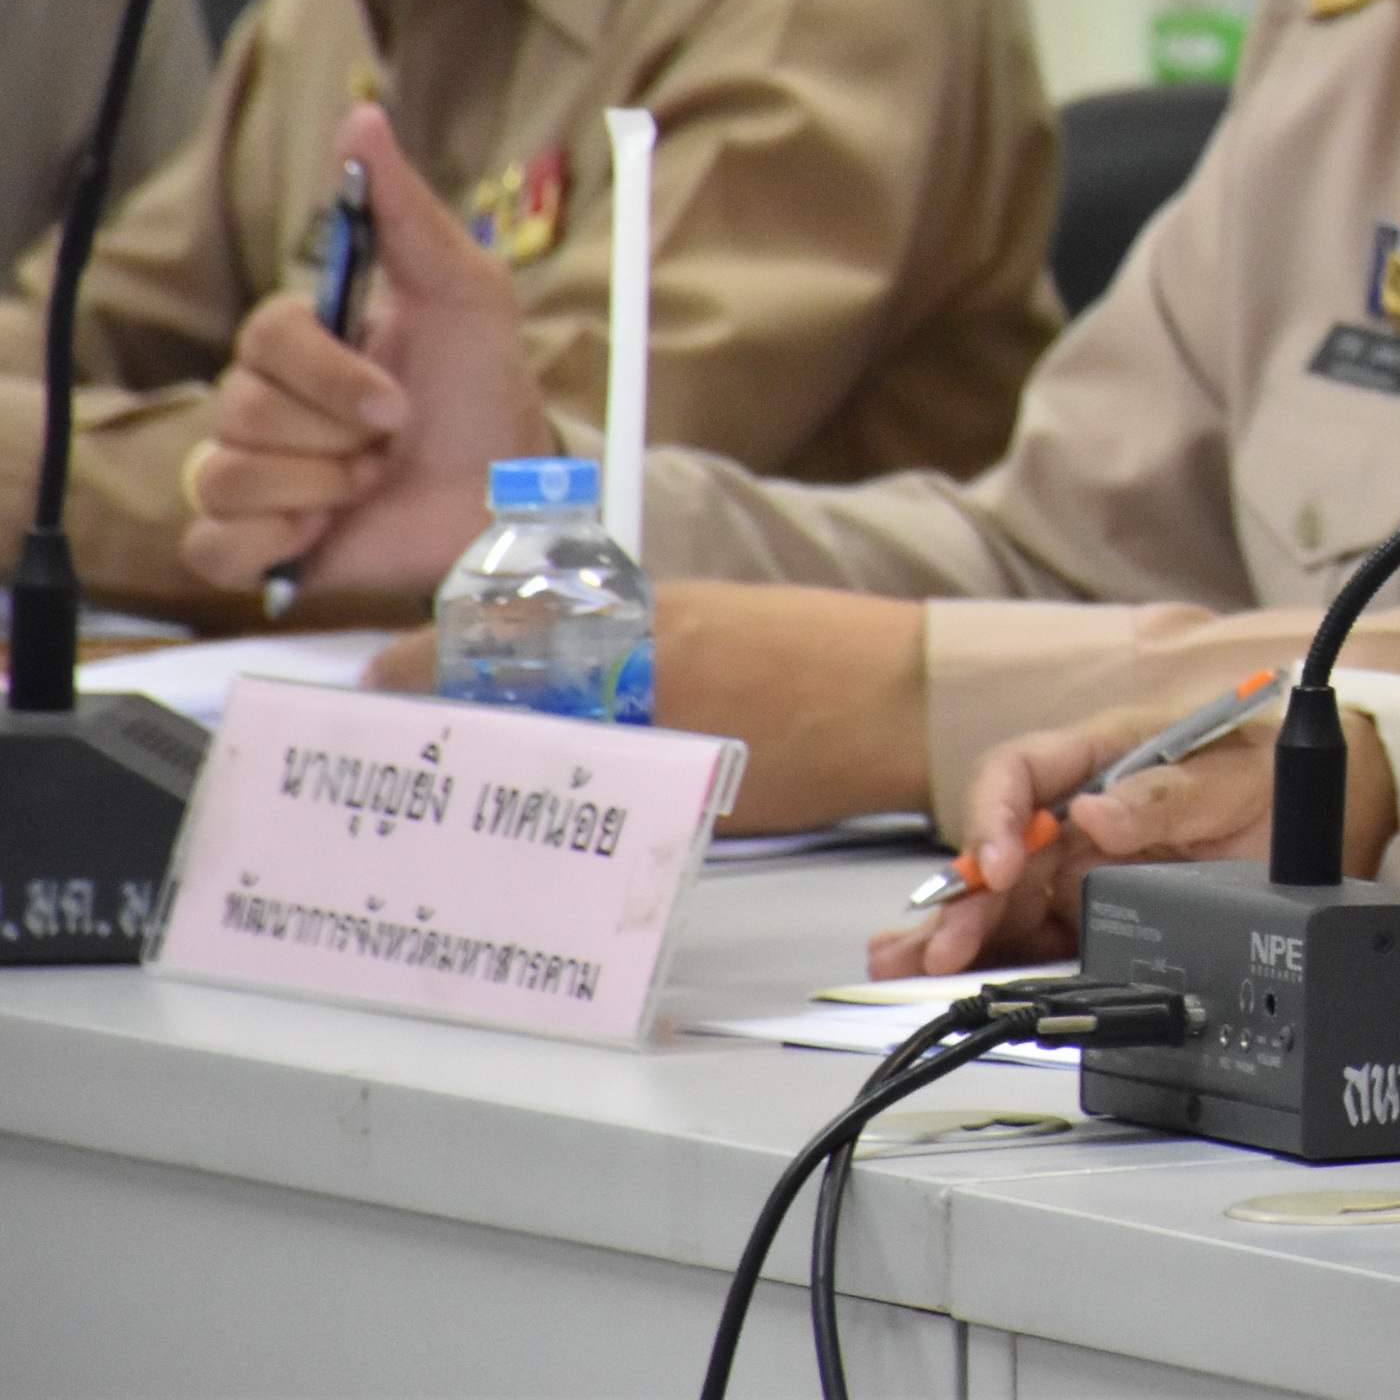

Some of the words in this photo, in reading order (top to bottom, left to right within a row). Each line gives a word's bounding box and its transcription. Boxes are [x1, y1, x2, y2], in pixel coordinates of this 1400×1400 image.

[280, 726, 454, 838] นางบุญยิ่ง
[473, 766, 629, 857] เทศน้อย
[221, 870, 601, 1001] พัฒนาการจังหวัดมหาสารคาม
[1251, 931, 1304, 971] NPE
